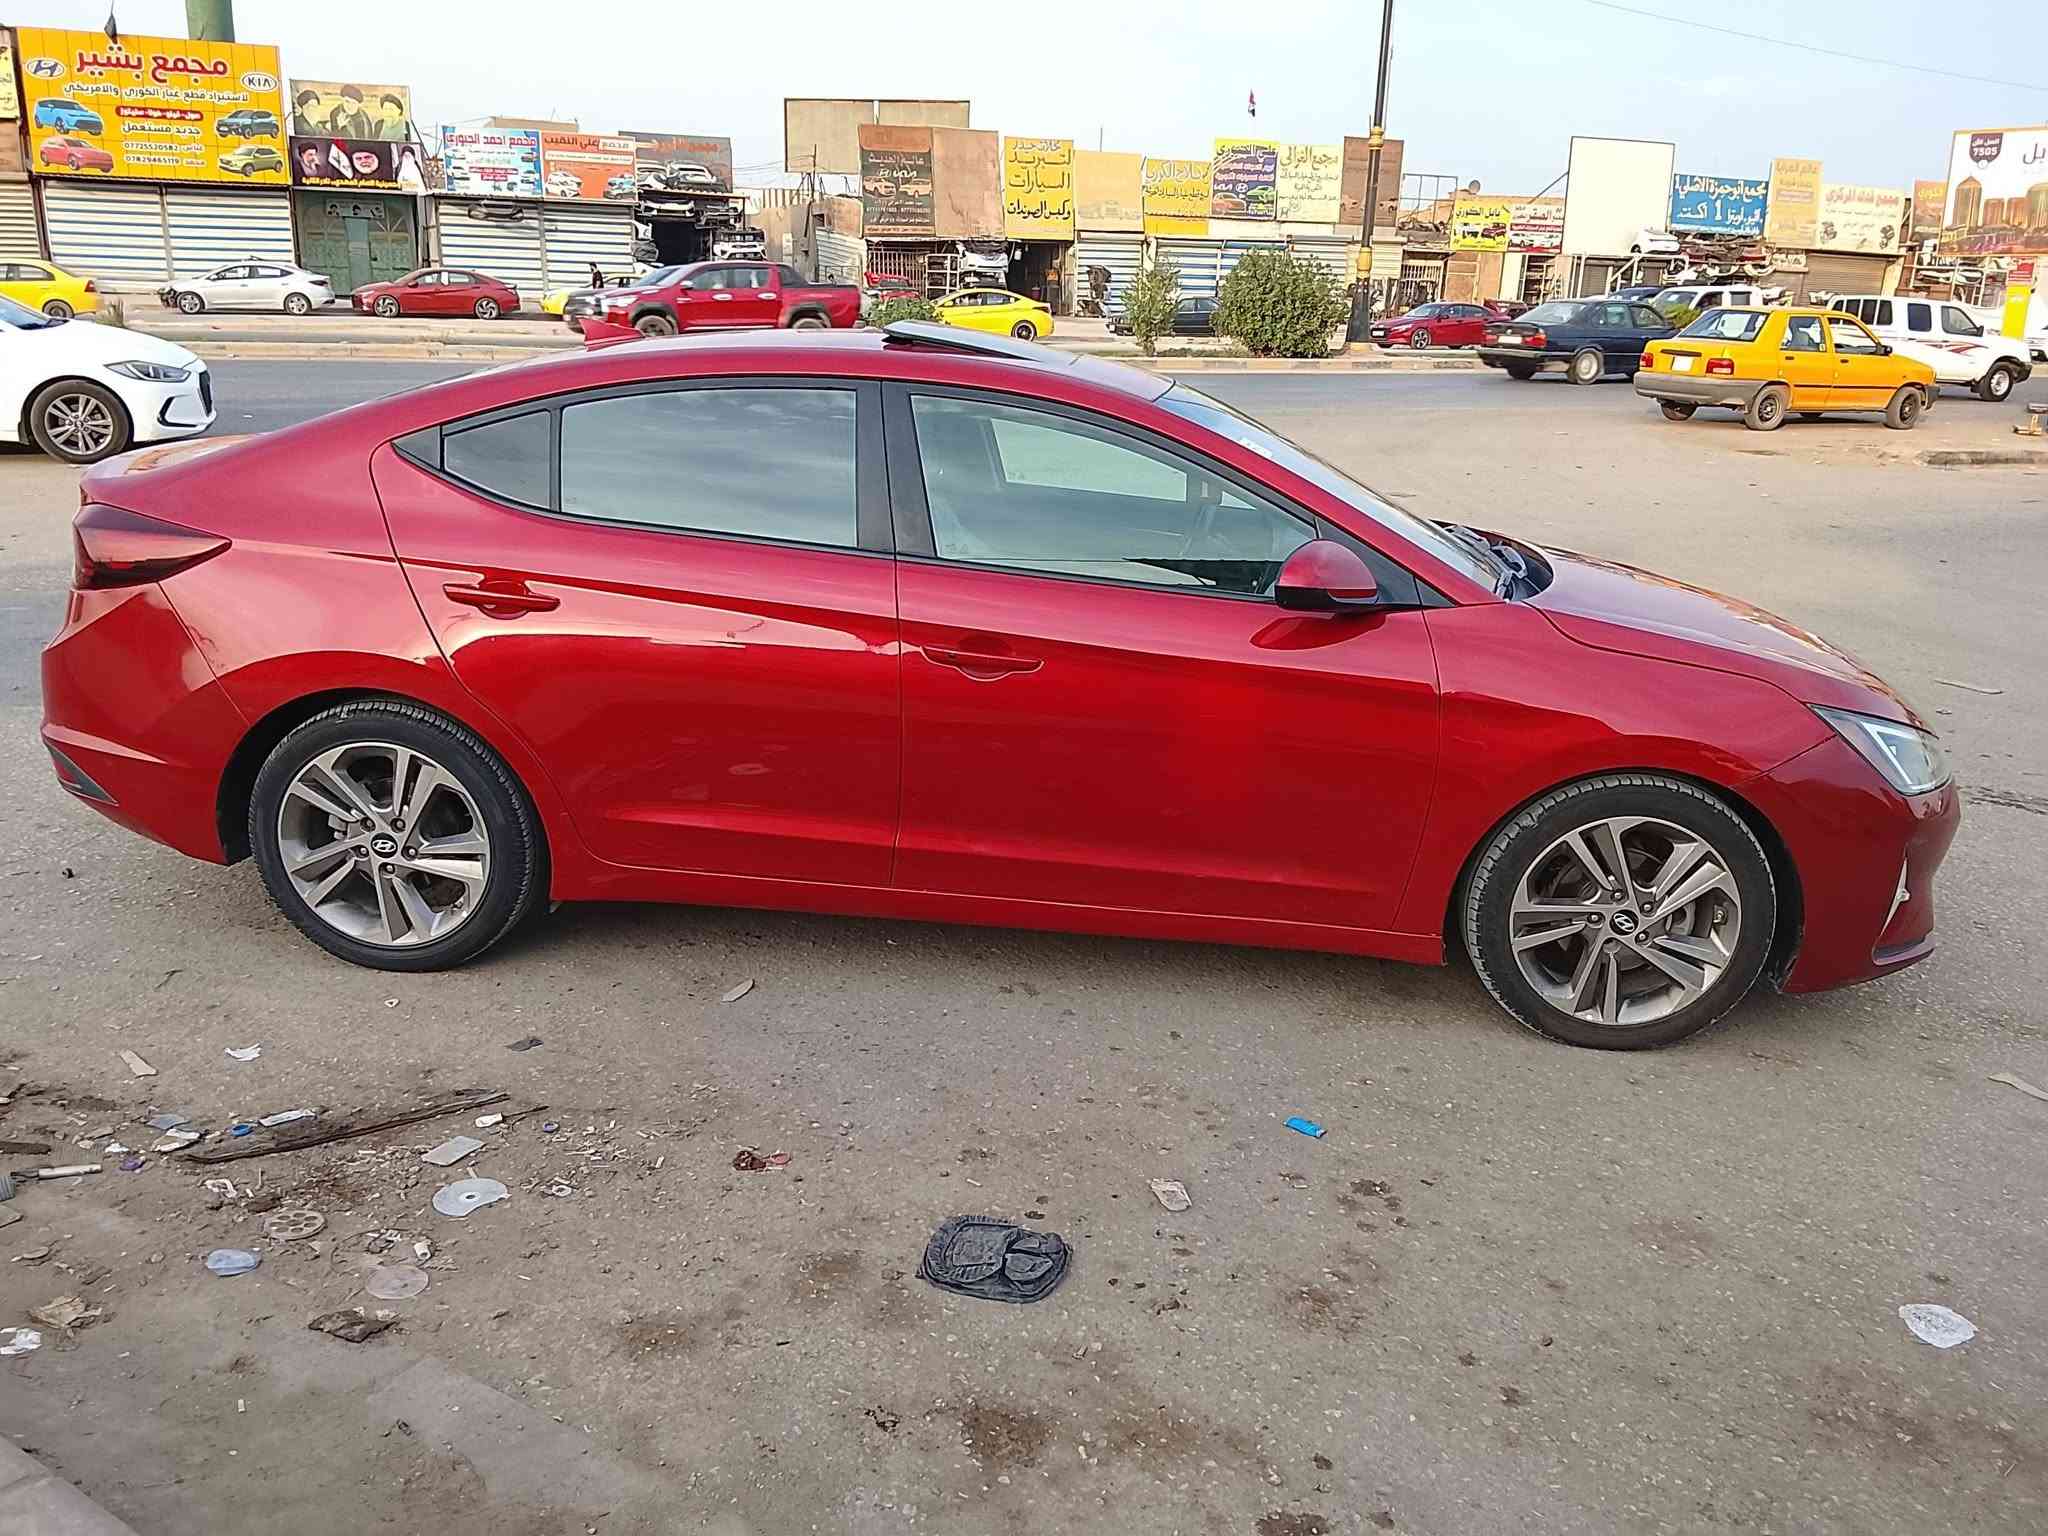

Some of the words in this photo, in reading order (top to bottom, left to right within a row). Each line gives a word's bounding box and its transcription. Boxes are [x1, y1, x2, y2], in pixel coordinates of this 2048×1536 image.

[76, 45, 144, 80] بشير
[151, 54, 229, 84] مجمع
[247, 76, 272, 89] KIA
[122, 122, 172, 134] مستعمل
[175, 126, 200, 137] جديد
[483, 135, 506, 145] احمد
[509, 136, 537, 149] مجمع
[1973, 146, 1998, 157] 7505
[1008, 149, 1072, 169] لتبريد
[1008, 169, 1071, 194] السيارات
[1743, 182, 1767, 203] مجمع
